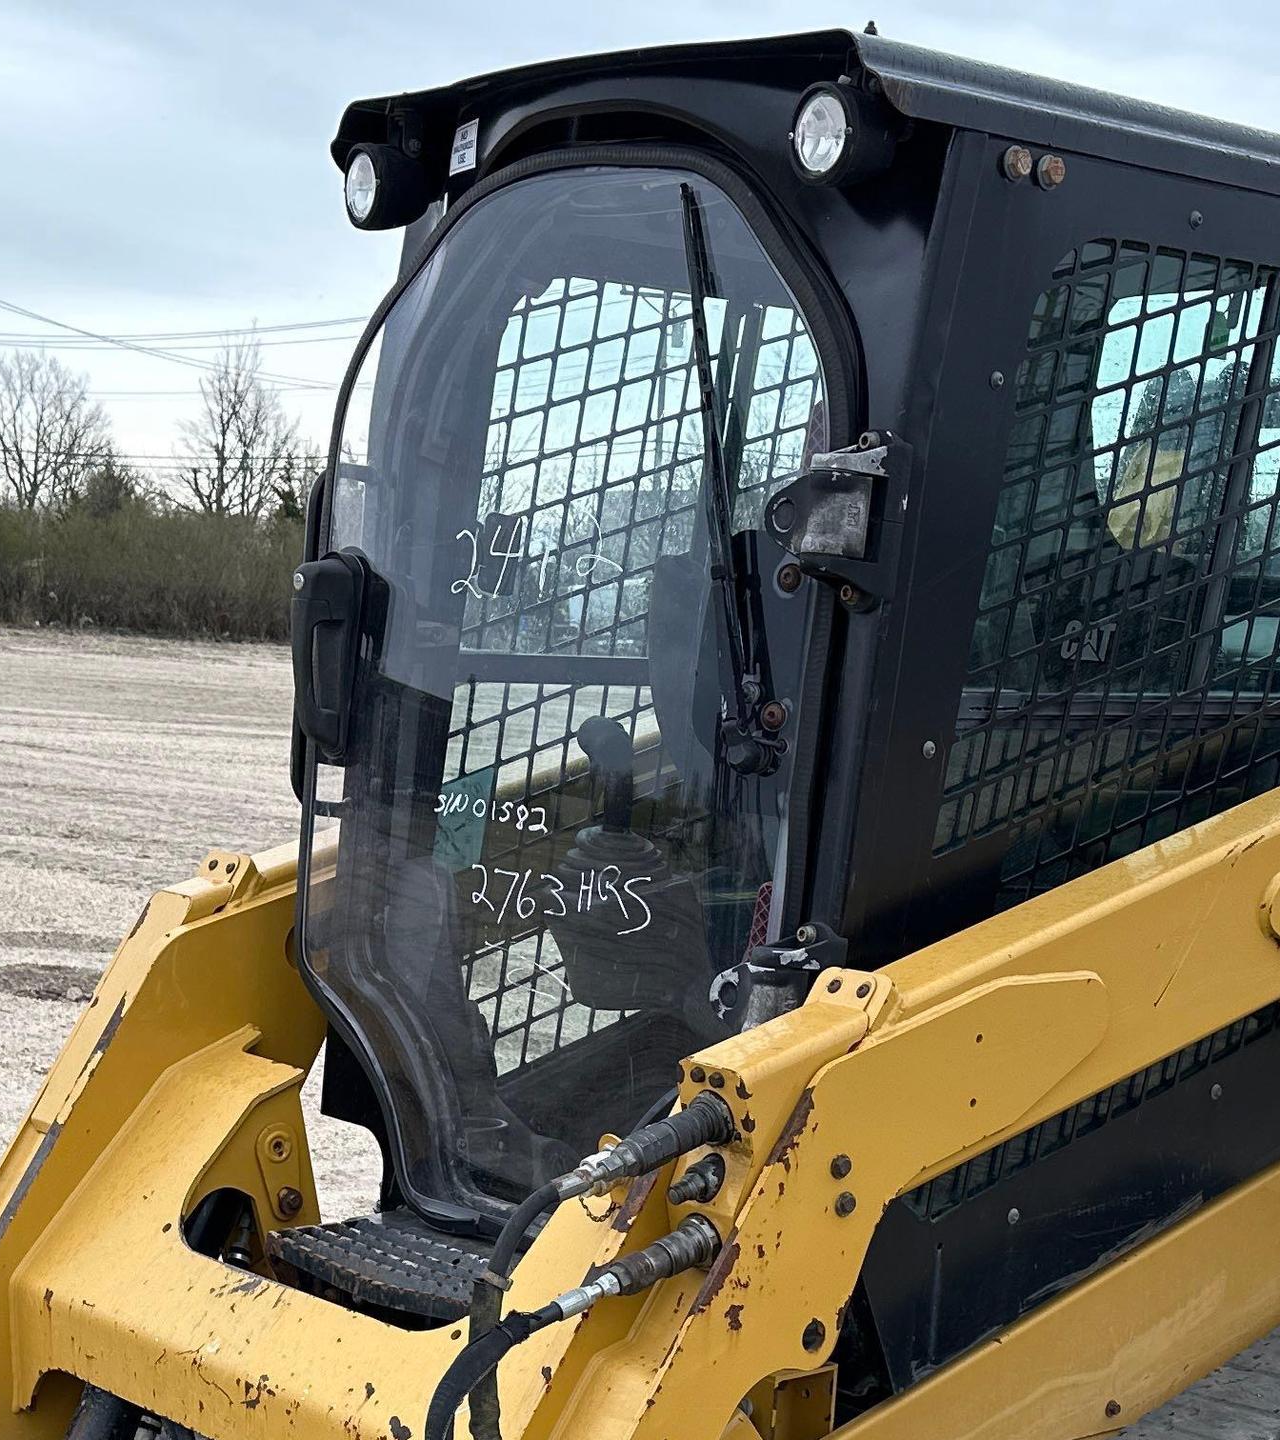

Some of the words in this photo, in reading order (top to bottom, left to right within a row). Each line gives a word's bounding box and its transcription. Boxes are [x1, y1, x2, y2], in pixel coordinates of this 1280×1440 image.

[457, 152, 466, 164] USE
[1060, 620, 1117, 662] CAT
[433, 792, 469, 817] S/N
[472, 798, 549, 835] 01582
[471, 864, 567, 924] 2763
[577, 865, 651, 935] HRS
